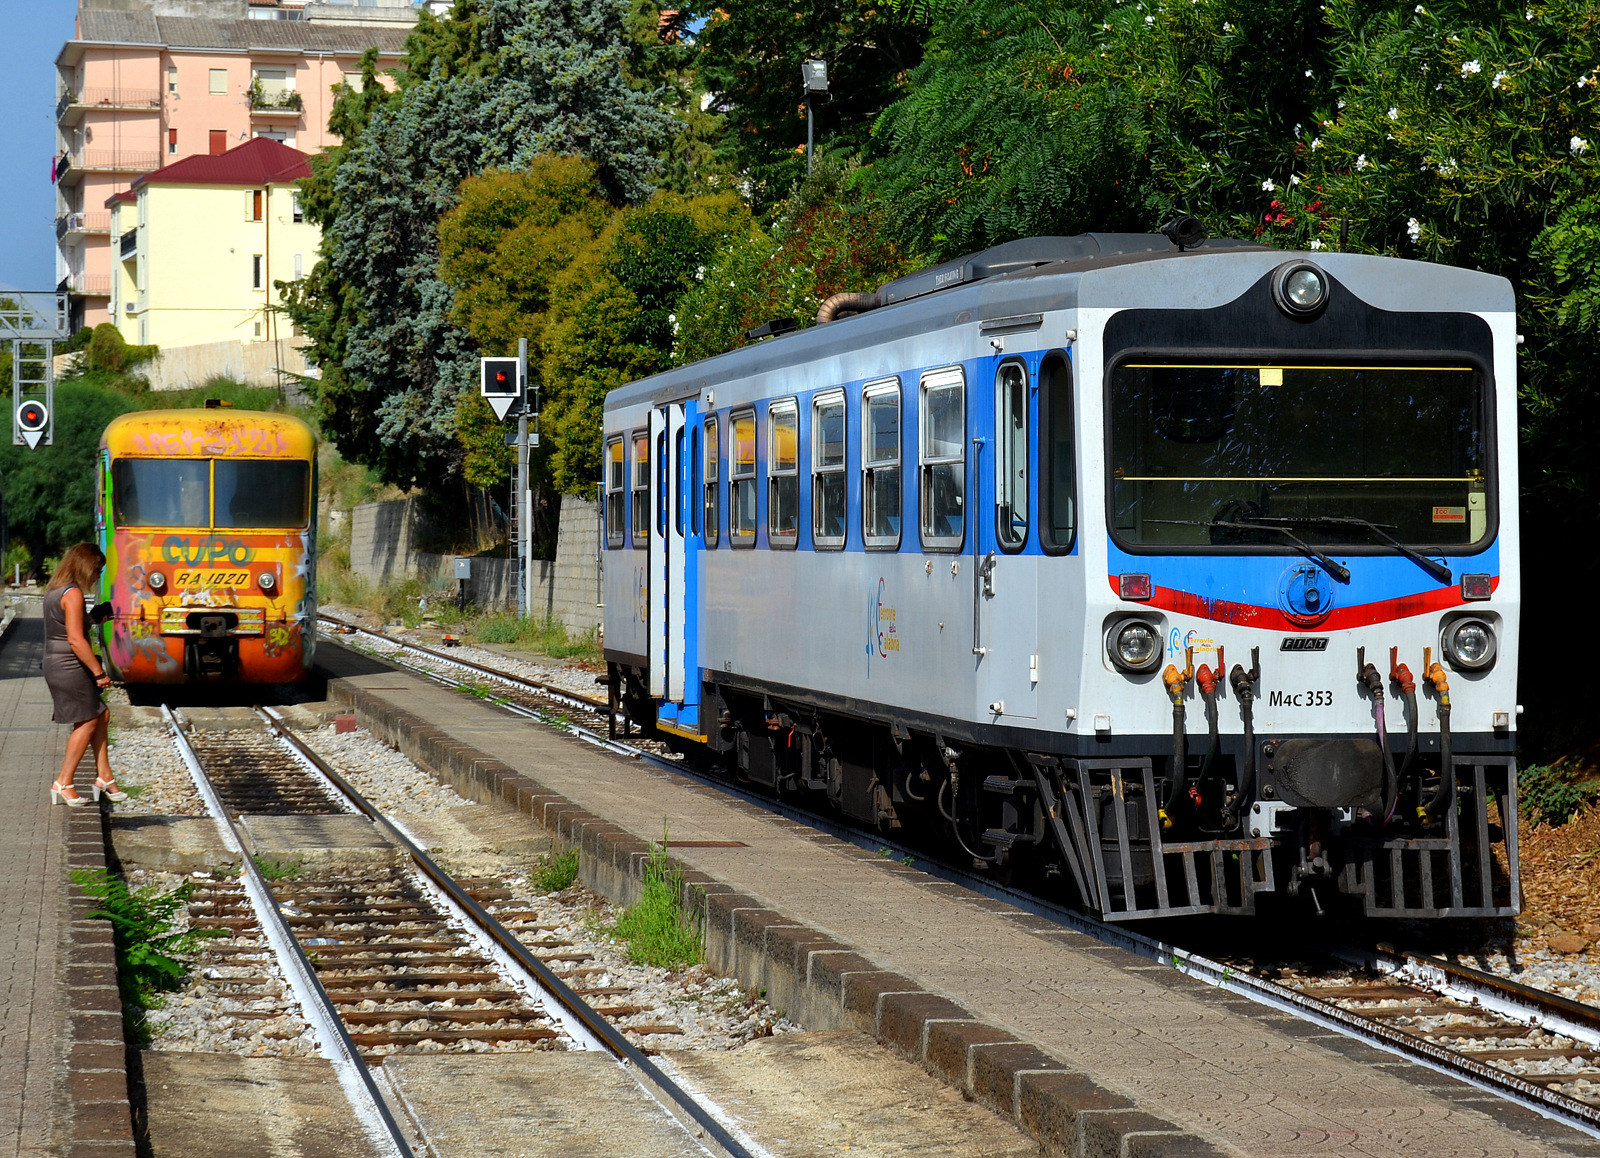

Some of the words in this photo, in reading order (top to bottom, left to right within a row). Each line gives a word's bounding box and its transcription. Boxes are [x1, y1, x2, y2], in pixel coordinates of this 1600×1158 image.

[176, 573, 201, 585] RA
[206, 573, 249, 585] 1020
[1284, 639, 1327, 649] FIAT
[1305, 690, 1332, 706] 353
